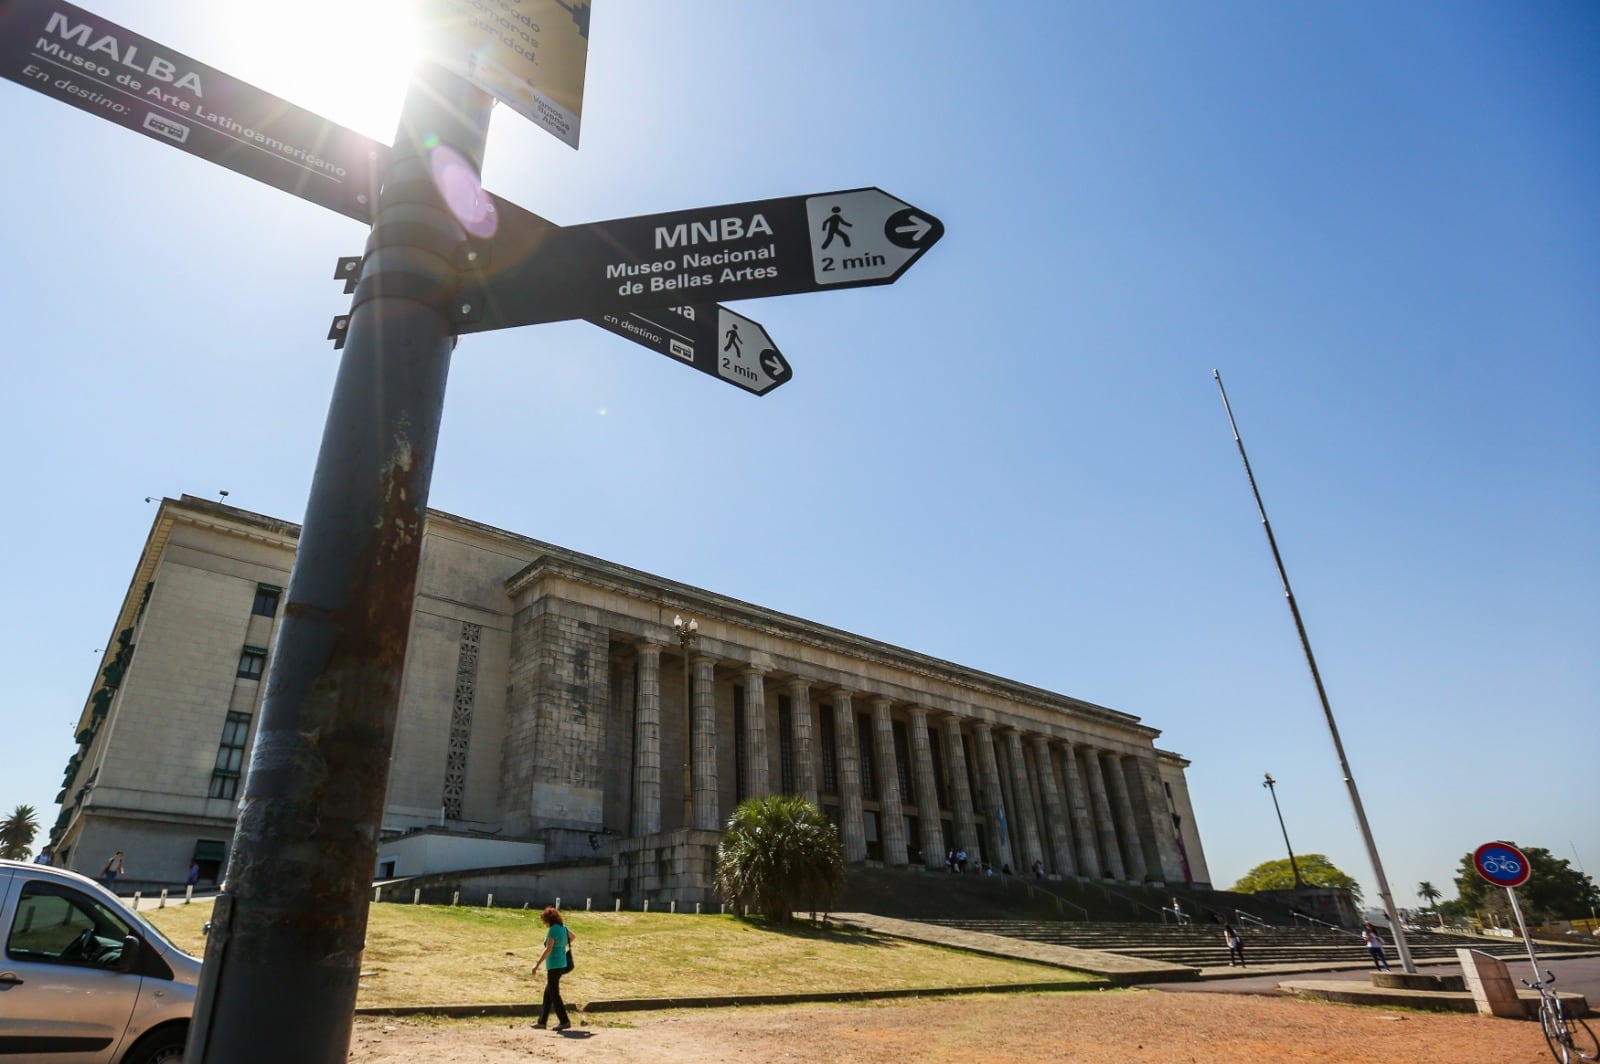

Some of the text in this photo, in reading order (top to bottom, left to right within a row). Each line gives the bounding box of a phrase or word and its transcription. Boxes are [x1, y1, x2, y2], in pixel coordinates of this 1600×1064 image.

[44, 12, 203, 97] MALBA
[22, 64, 131, 115] En destino:
[35, 38, 346, 177] Museo de Arte Latinoamericano
[533, 95, 563, 119] Vamos
[538, 104, 570, 130] Buenos
[542, 115, 566, 135] Aires
[655, 213, 774, 250] MNBA
[606, 244, 776, 279] Museo Nacional
[821, 253, 886, 272] 2 min
[618, 266, 778, 296] de Bellas Artes
[621, 320, 663, 345] destino:
[722, 357, 759, 383] 2 min
